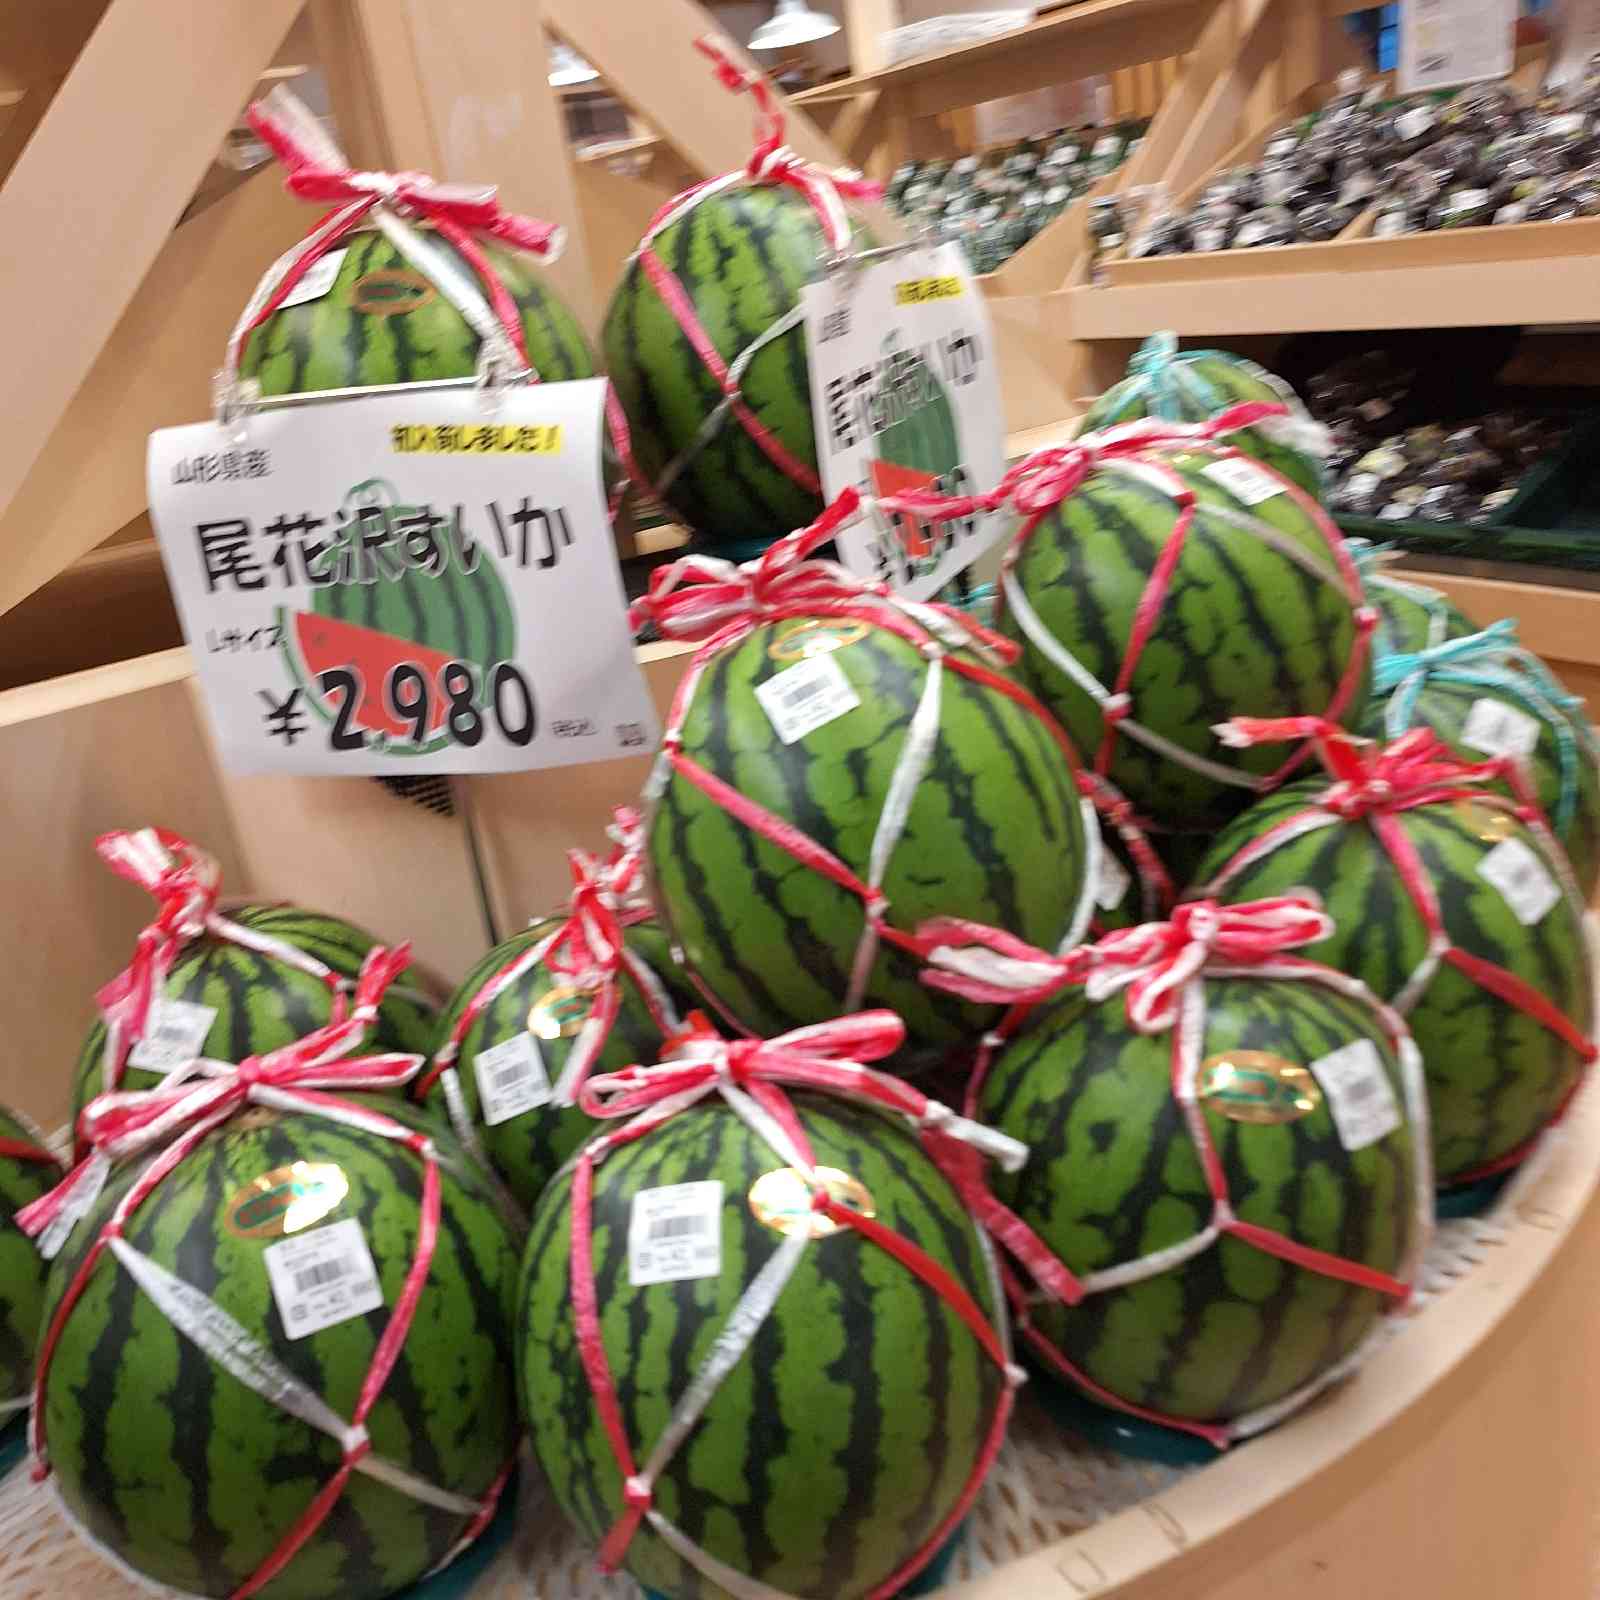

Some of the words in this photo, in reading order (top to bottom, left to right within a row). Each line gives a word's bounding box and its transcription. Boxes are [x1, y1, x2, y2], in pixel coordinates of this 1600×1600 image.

[196, 496, 575, 593] 尾花沢すいか
